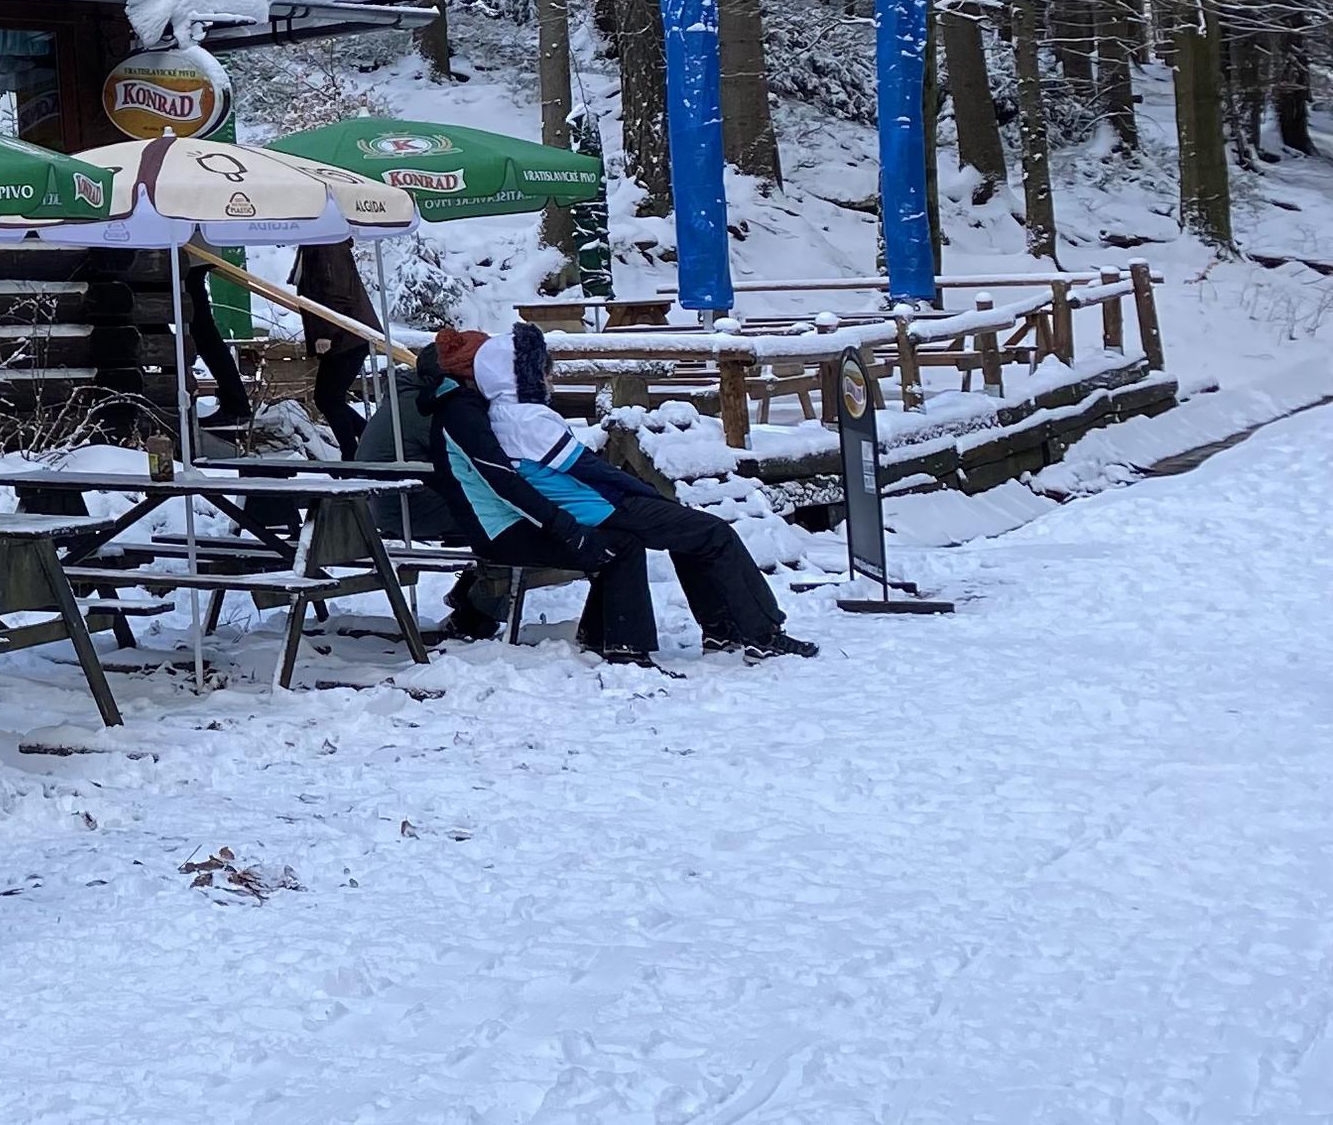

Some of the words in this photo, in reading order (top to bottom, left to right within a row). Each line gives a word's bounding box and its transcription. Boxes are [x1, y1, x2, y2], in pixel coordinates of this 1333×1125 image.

[122, 83, 193, 117] KONRAD
[392, 140, 417, 151] K
[389, 172, 458, 191] KONRAD
[580, 172, 596, 183] PIVO
[356, 199, 386, 213] ALGIDA
